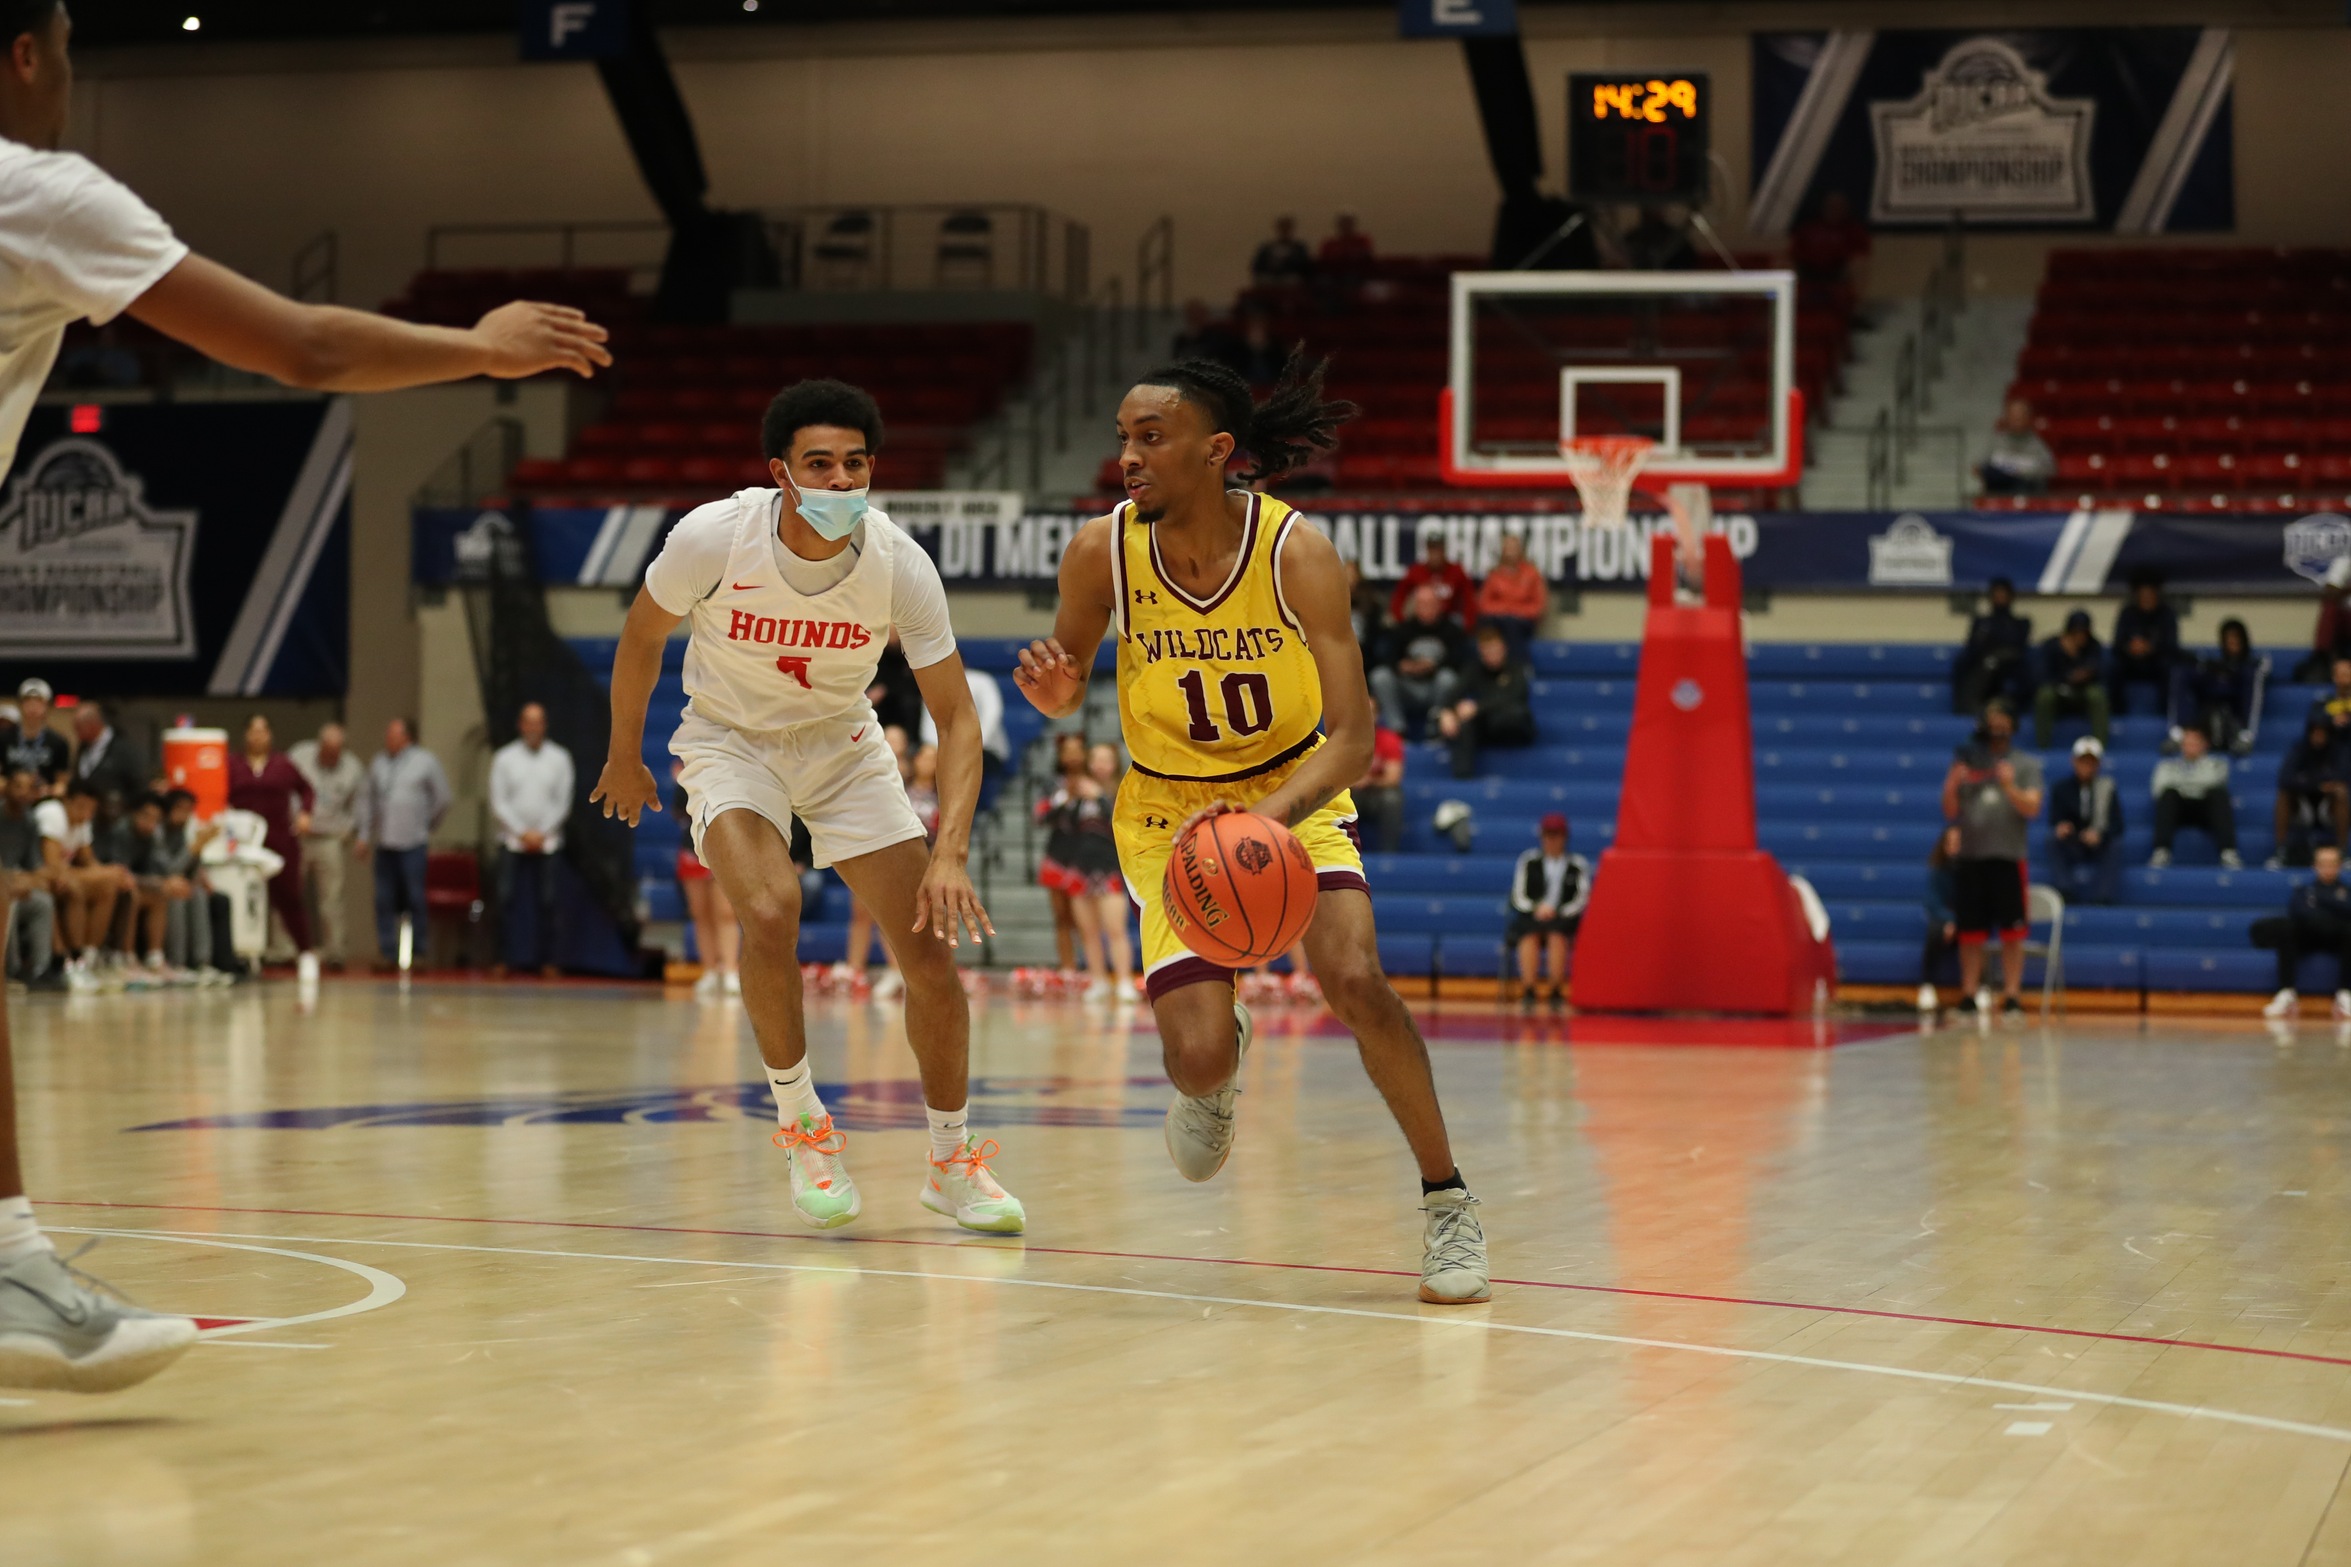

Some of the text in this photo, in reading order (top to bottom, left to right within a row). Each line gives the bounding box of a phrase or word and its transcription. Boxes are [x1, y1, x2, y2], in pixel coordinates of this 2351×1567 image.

[550, 3, 596, 47] F
[1594, 79, 1697, 123] 14:29
[727, 608, 872, 650] HOUNDS
[1135, 627, 1284, 664] WILDCATS
[1177, 669, 1274, 742] 10
